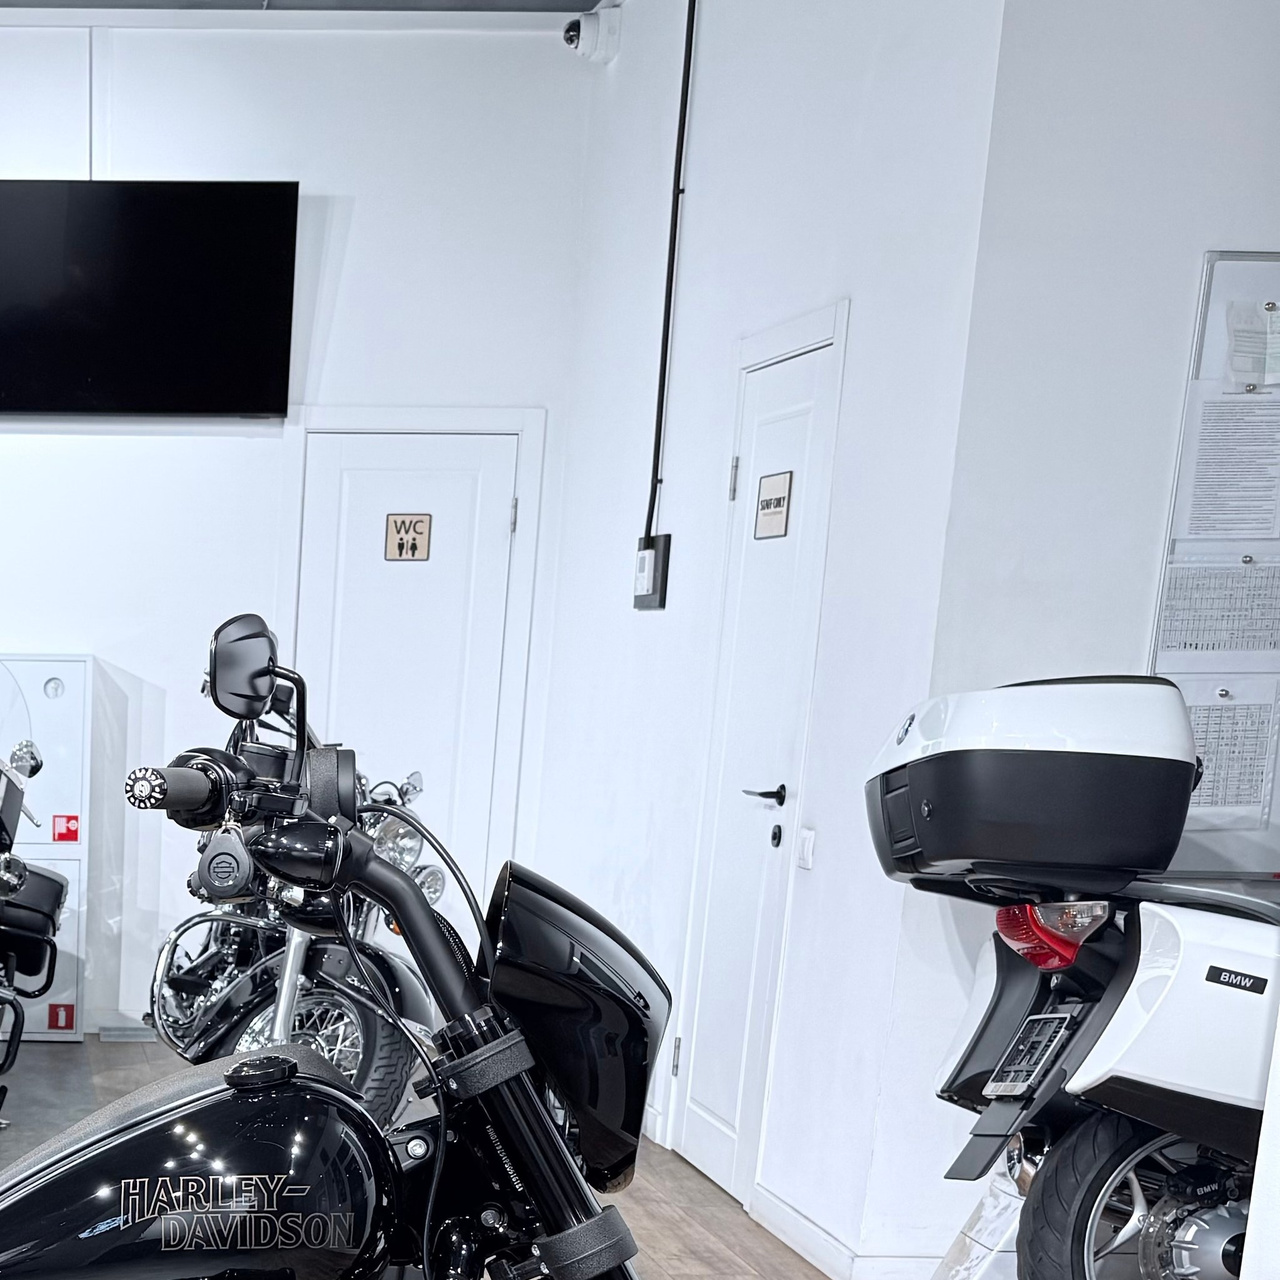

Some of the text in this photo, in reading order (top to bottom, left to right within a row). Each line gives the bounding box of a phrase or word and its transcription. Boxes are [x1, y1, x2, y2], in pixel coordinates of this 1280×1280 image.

[393, 519, 425, 535] WC
[1219, 971, 1254, 988] BMW
[1196, 1182, 1219, 1196] BMW
[120, 1174, 311, 1231] HARLEY-
[160, 1212, 355, 1251] DAVIDSON
